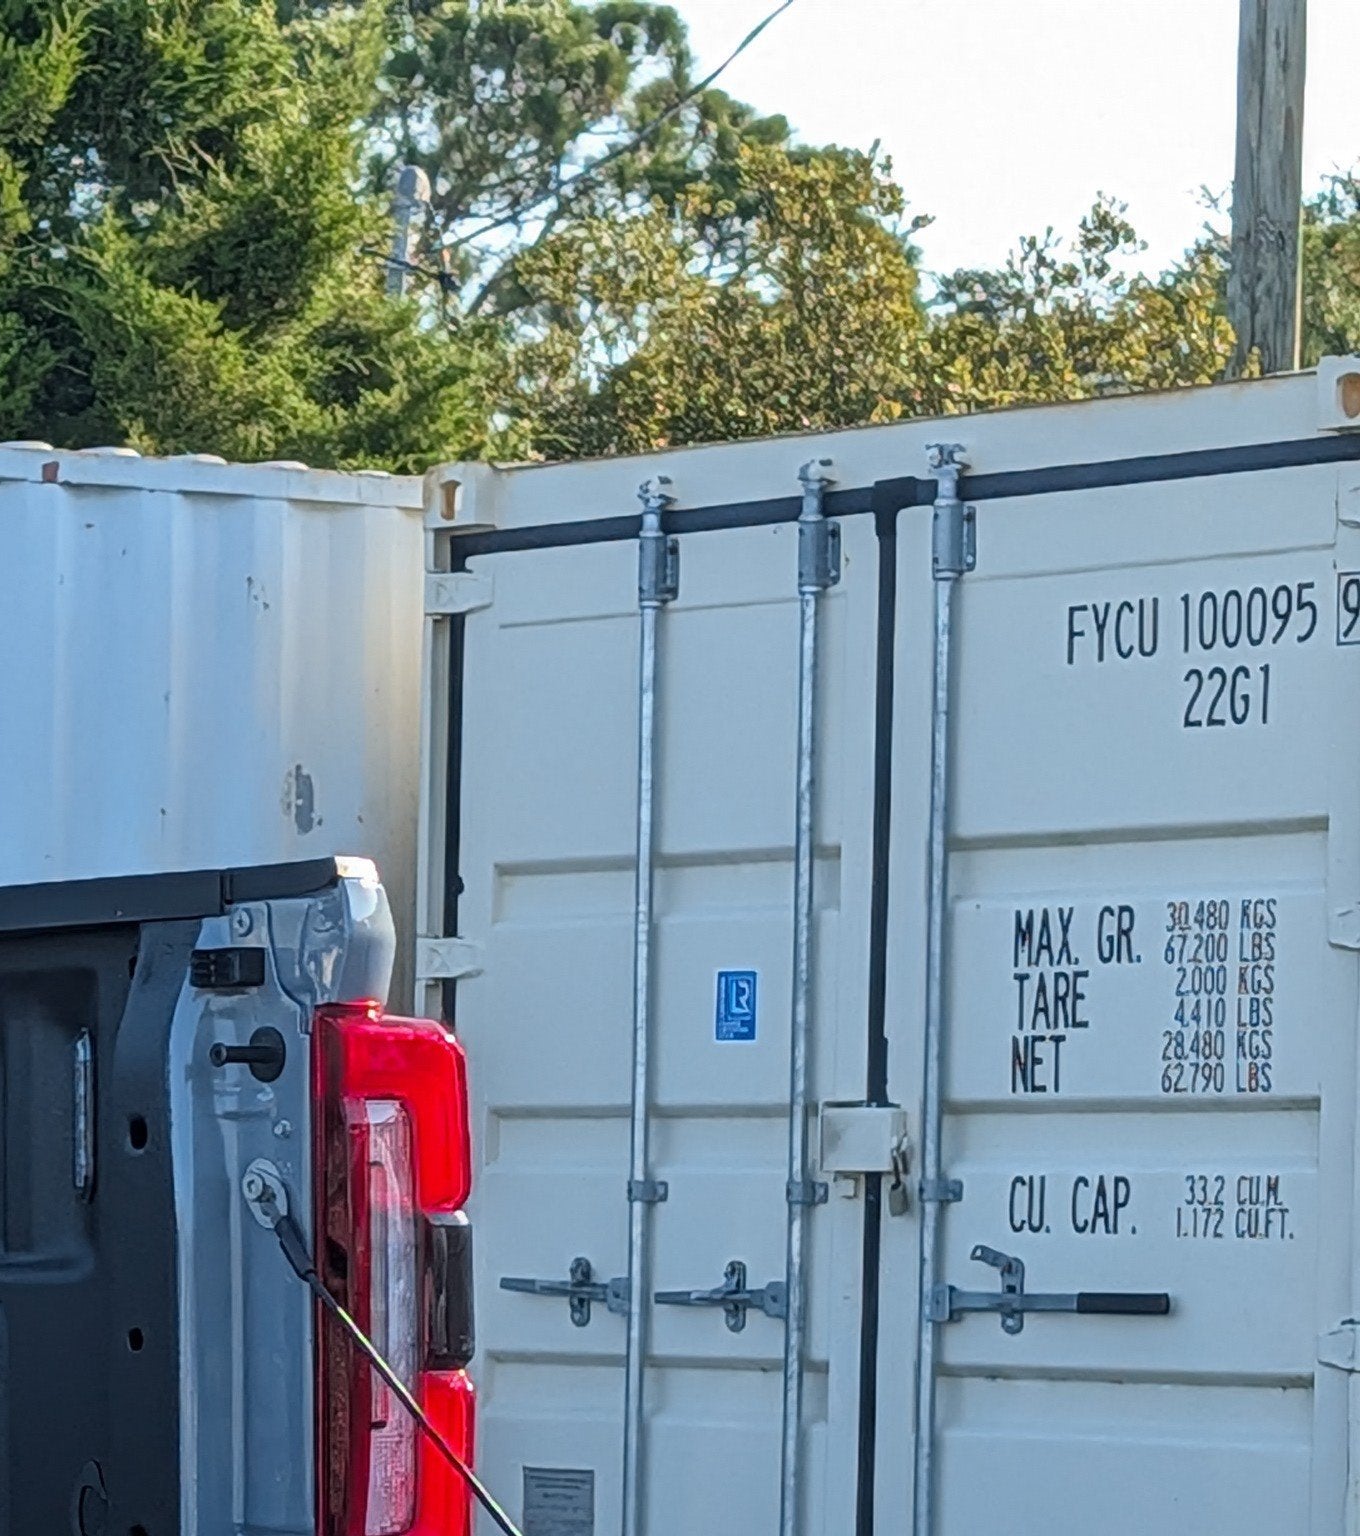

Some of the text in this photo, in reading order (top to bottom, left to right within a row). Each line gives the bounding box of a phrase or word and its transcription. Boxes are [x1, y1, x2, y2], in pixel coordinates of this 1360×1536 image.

[1067, 578, 1360, 664] FYCU 100095 9
[1183, 663, 1271, 728] 22G1
[1013, 904, 1142, 967] MAX. GR.
[1241, 898, 1278, 930] KGS
[1239, 931, 1276, 962] LBS
[1013, 970, 1089, 1031] TARE
[1237, 964, 1275, 995] KGS
[1237, 996, 1274, 1028] LBS
[1011, 1034, 1066, 1093] NET
[1236, 1029, 1273, 1060] KGS
[1236, 1061, 1272, 1093] LBS
[1009, 1174, 1137, 1235] CU. CAP.
